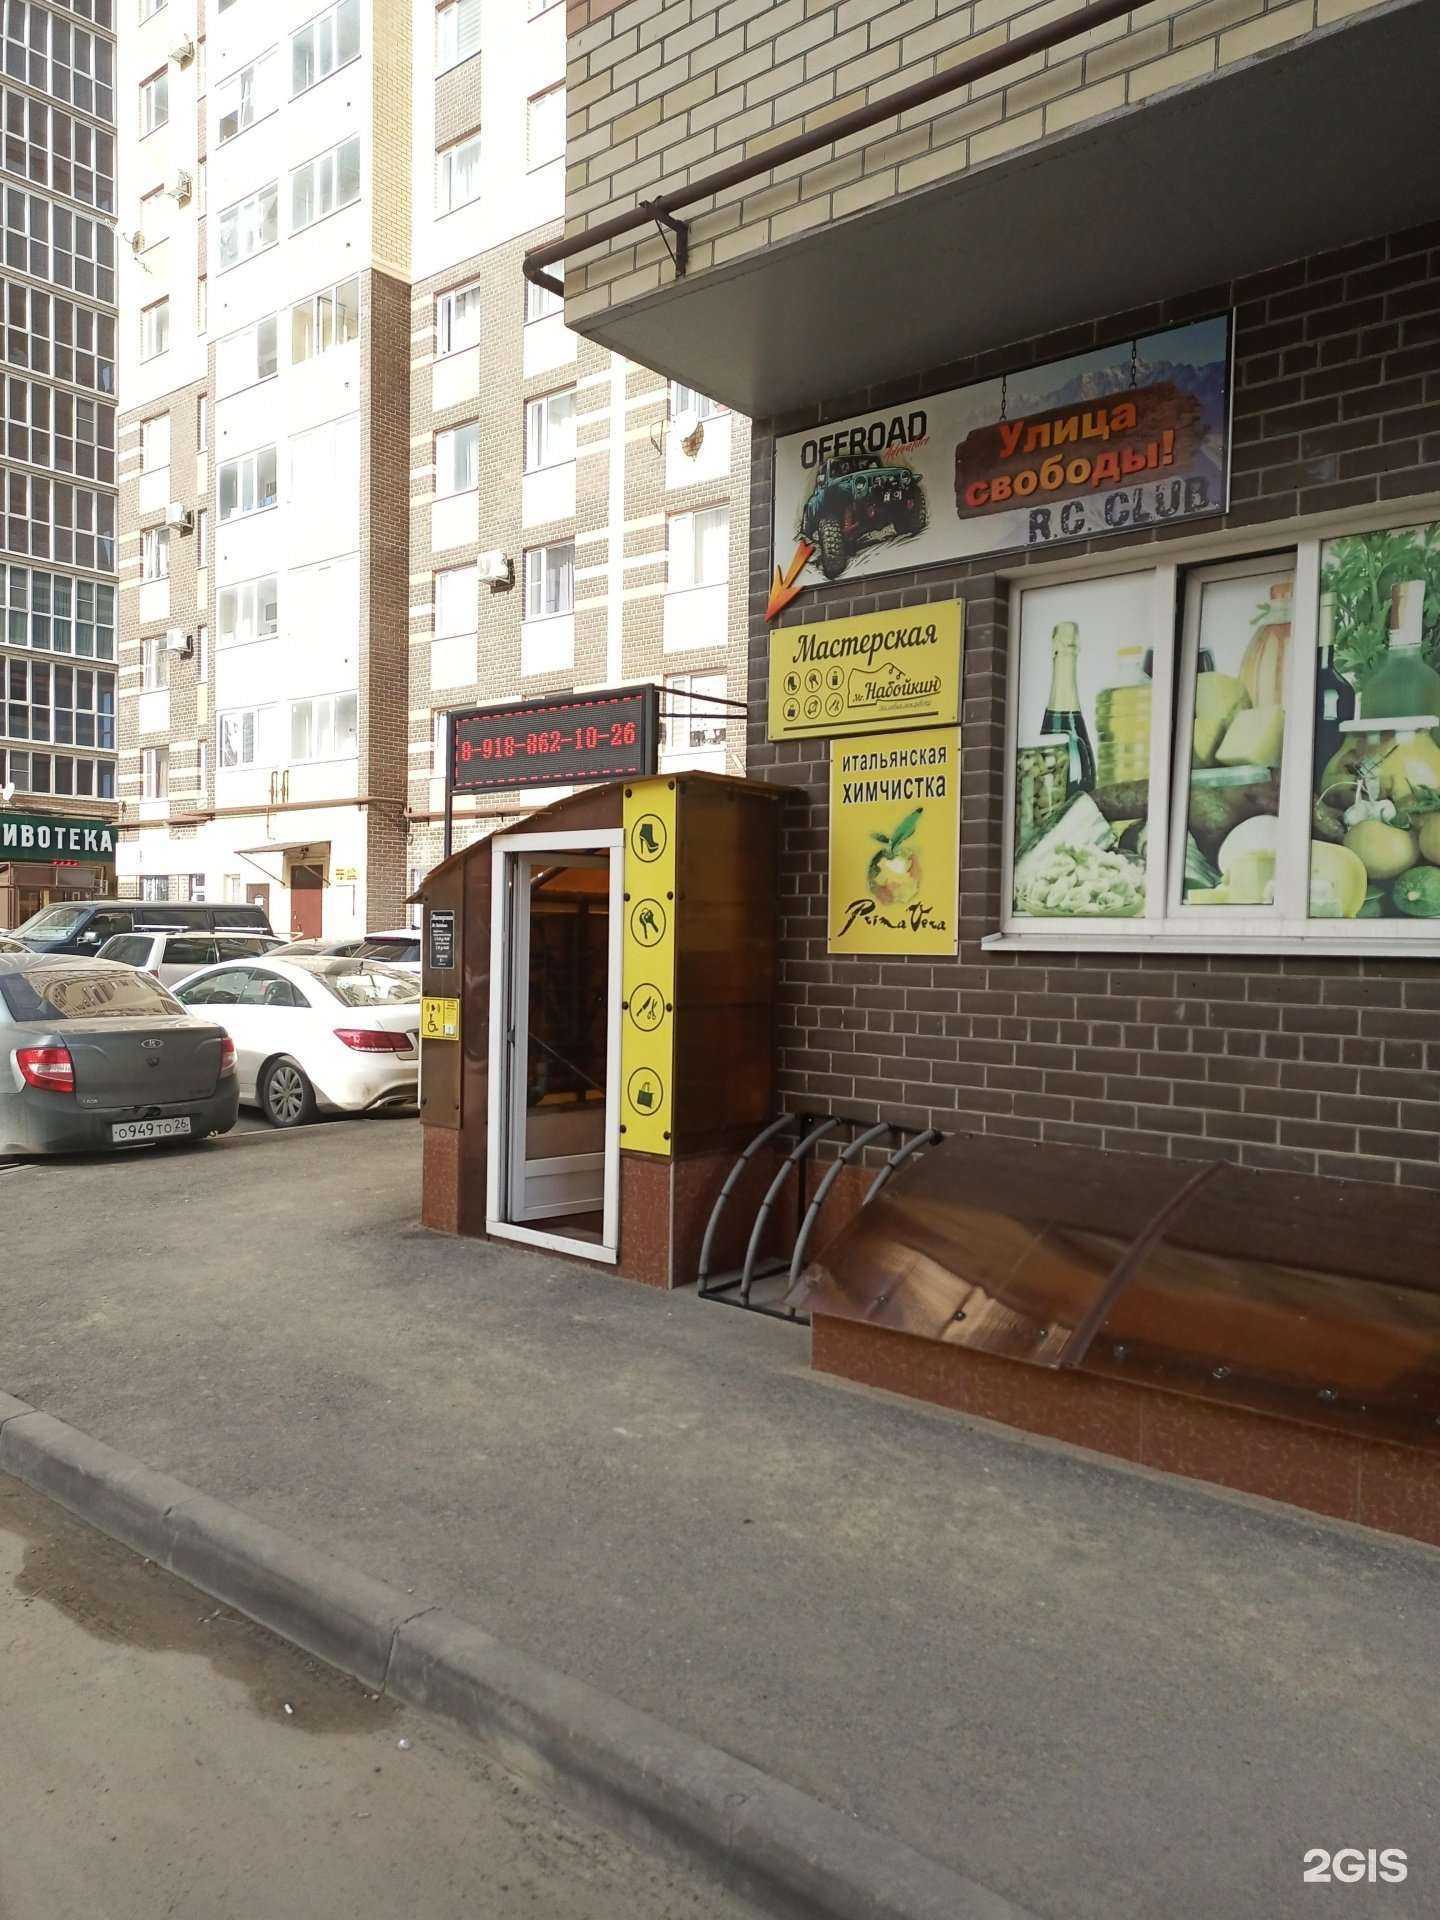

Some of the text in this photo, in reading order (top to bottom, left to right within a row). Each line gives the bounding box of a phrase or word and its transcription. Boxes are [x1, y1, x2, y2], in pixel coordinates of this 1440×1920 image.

[801, 410, 927, 470] OFFROAD
[997, 402, 1137, 459] Улица
[964, 429, 1176, 508] свободы!
[1104, 476, 1210, 527] CLUB
[792, 624, 937, 666] Мастерская
[864, 676, 941, 701] Набойкин
[461, 721, 637, 762] 8-918-862-10-26
[2, 823, 113, 852] ИВОТЕКА
